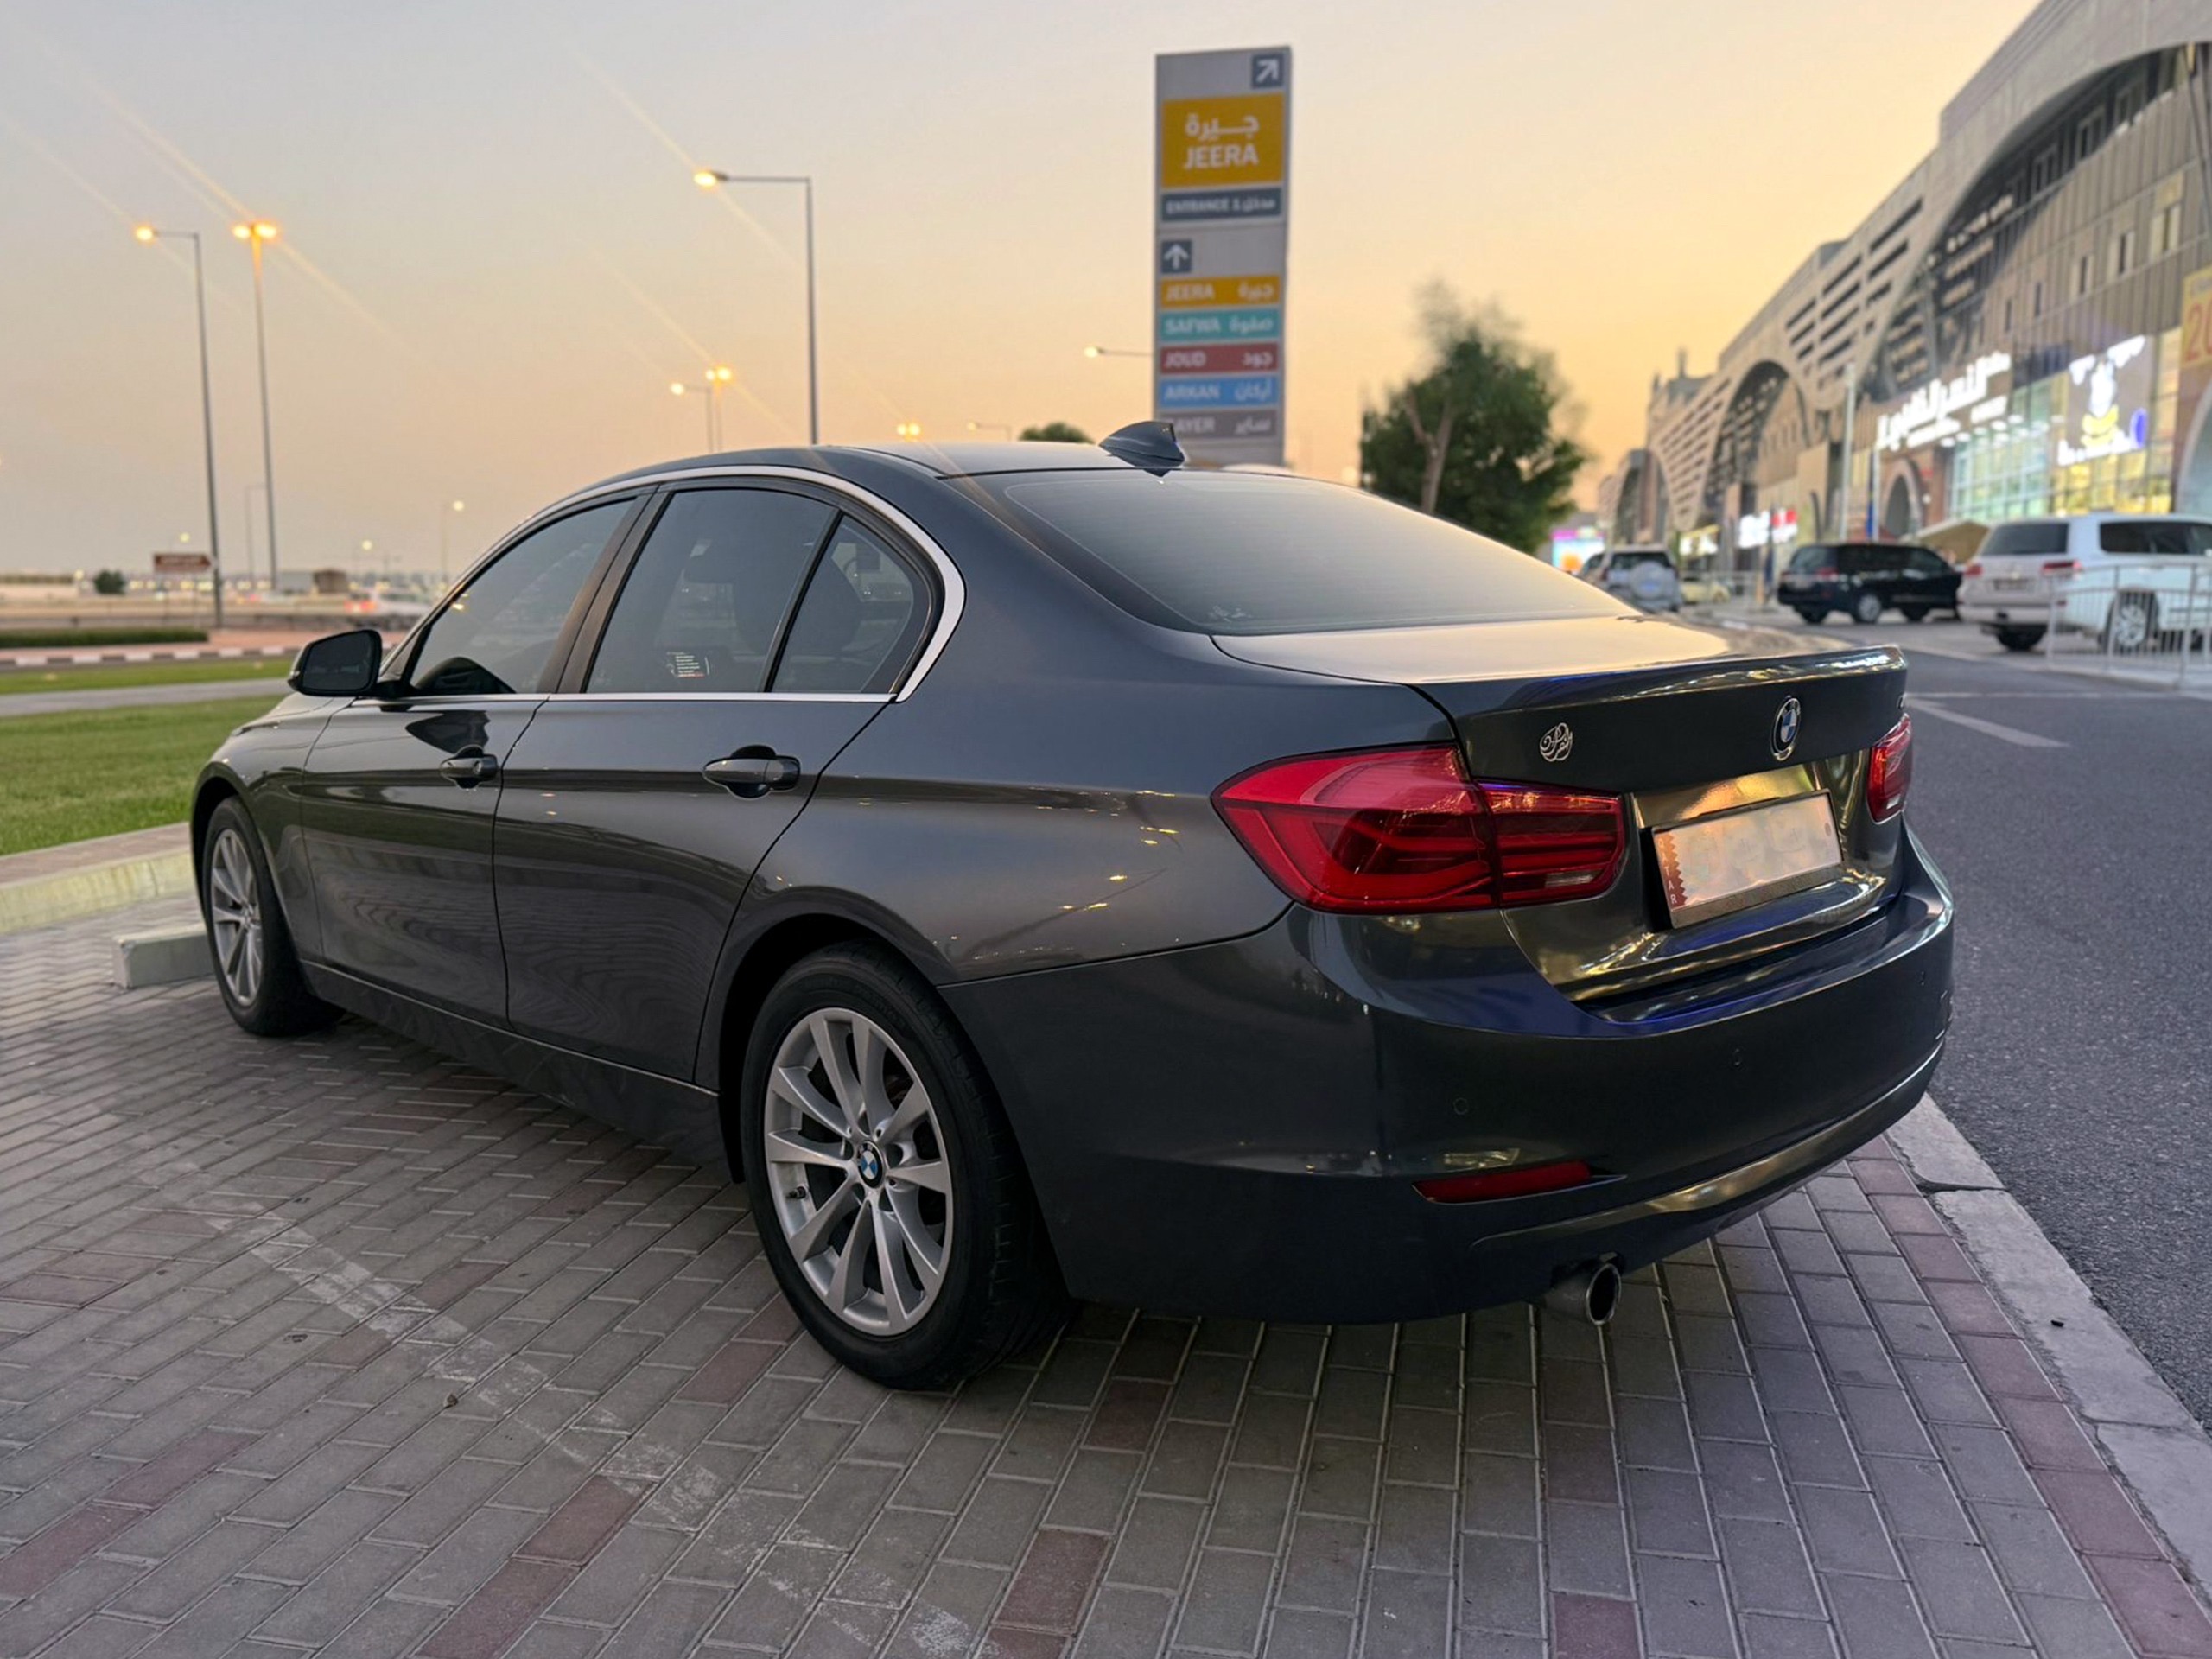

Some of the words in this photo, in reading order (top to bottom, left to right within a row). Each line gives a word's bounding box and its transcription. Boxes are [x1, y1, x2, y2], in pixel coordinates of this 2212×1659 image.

[1185, 113, 1260, 142] جيرة
[1183, 143, 1259, 169] JEERA
[1166, 199, 1229, 214] ENTRANCE
[1166, 283, 1215, 302] JEERA
[1166, 316, 1221, 335] SAFWA
[1165, 350, 1207, 369] JOUD
[1165, 385, 1220, 402] ARKAN
[1167, 417, 1215, 433] AYER
[1658, 837, 1677, 904] QATAR
